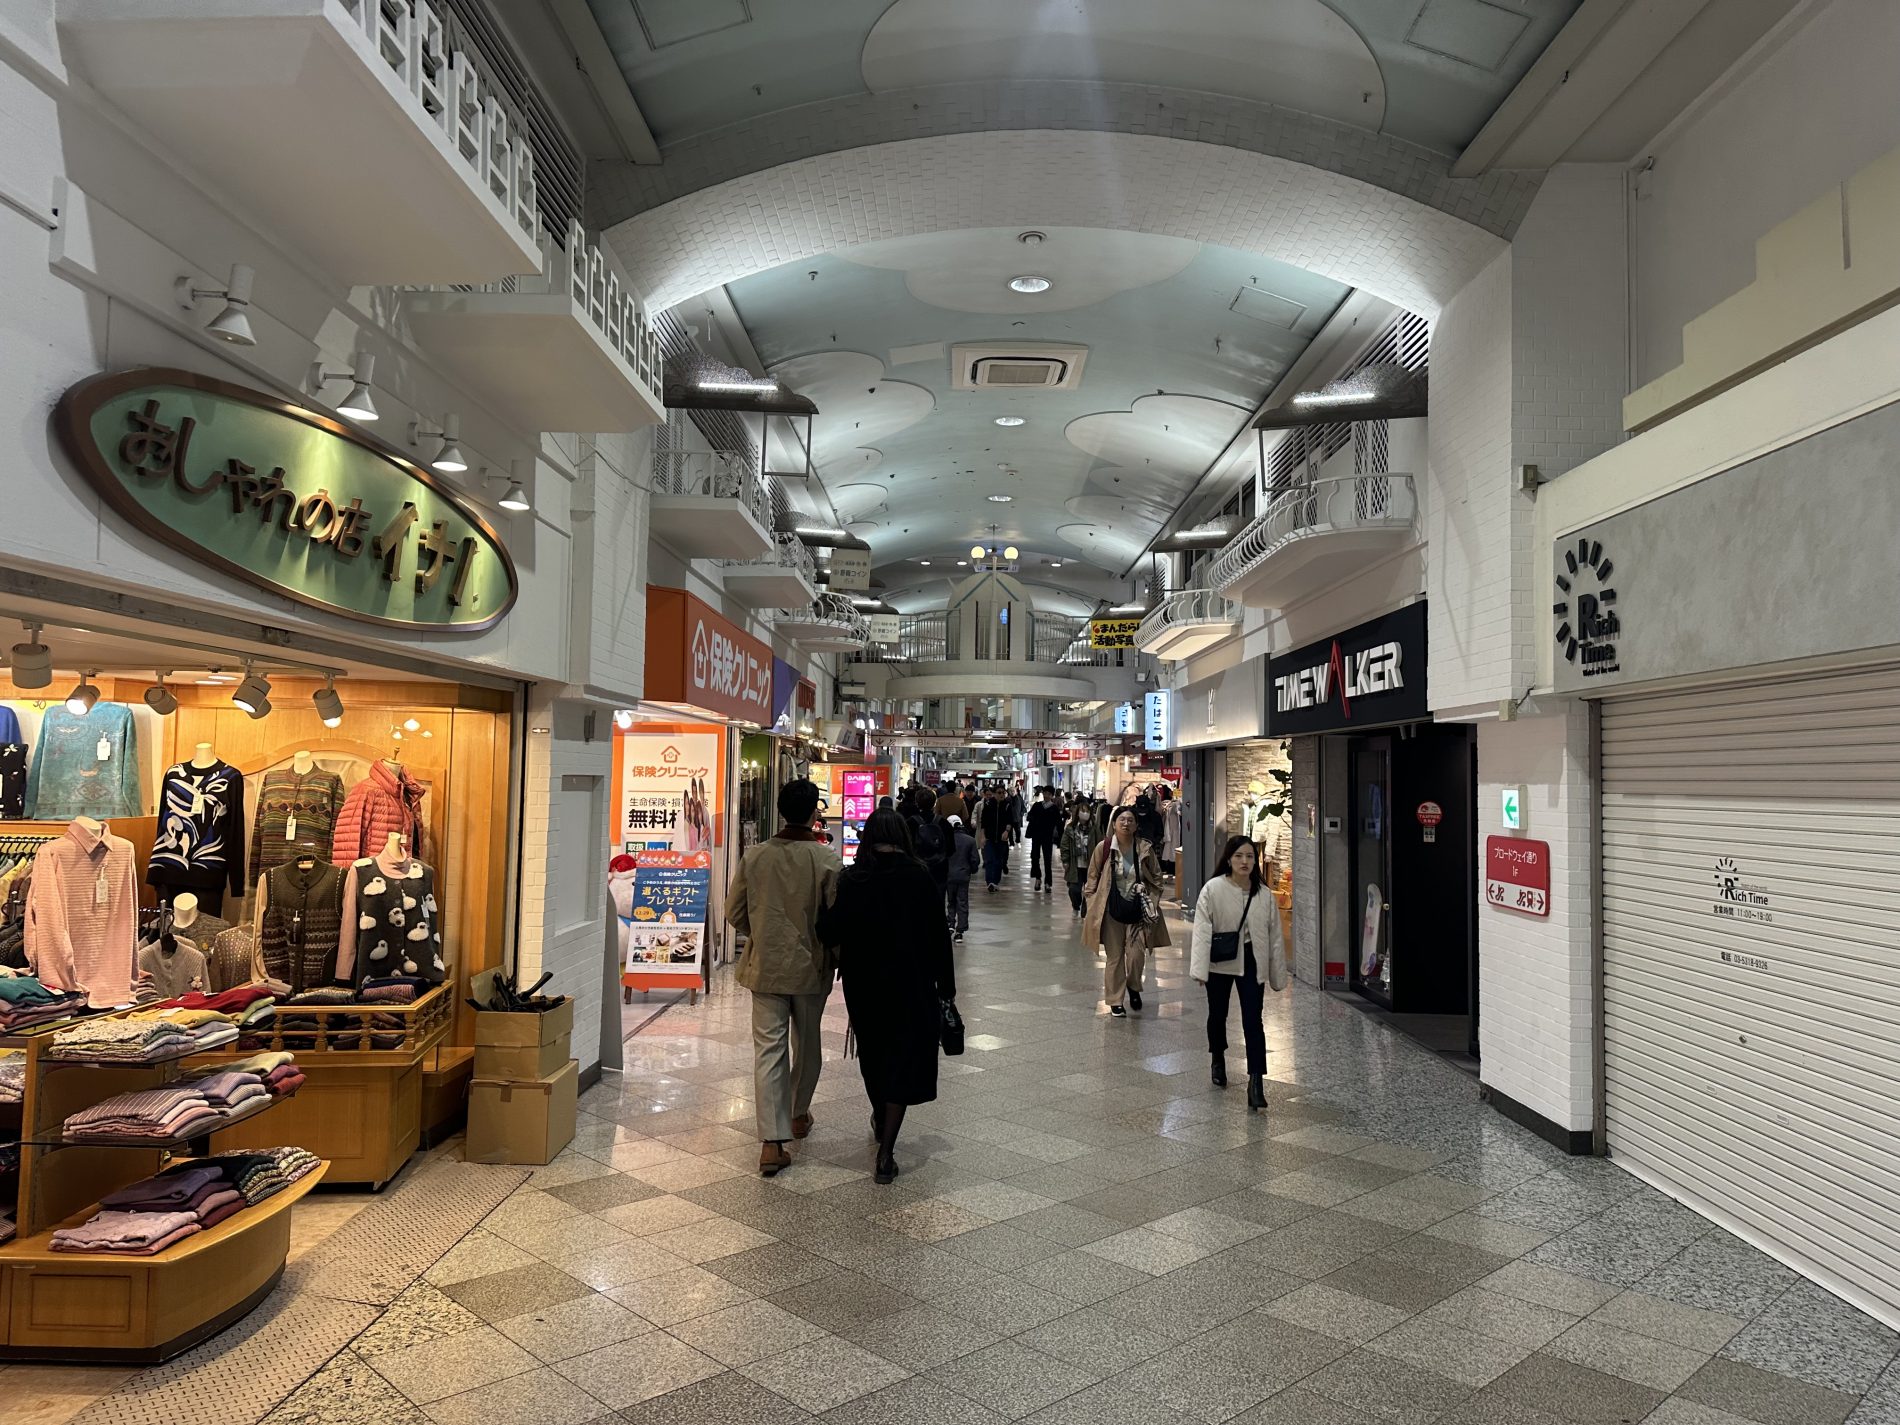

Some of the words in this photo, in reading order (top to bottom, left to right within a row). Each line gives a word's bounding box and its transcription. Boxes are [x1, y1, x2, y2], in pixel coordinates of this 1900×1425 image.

[119, 399, 374, 559] おしゃれの店
[1578, 593, 1618, 640] Rich
[1579, 641, 1615, 664] Time
[710, 629, 771, 709] 保険クリニック
[1275, 640, 1404, 720] TIMEWALKER
[632, 766, 708, 778] 保険クリニック
[1494, 846, 1538, 865] ブロードウェイ通り
[641, 886, 700, 896] 選べるギフト
[646, 896, 694, 905] プレゼント
[1724, 878, 1747, 902] Rich
[1748, 892, 1769, 905] Time
